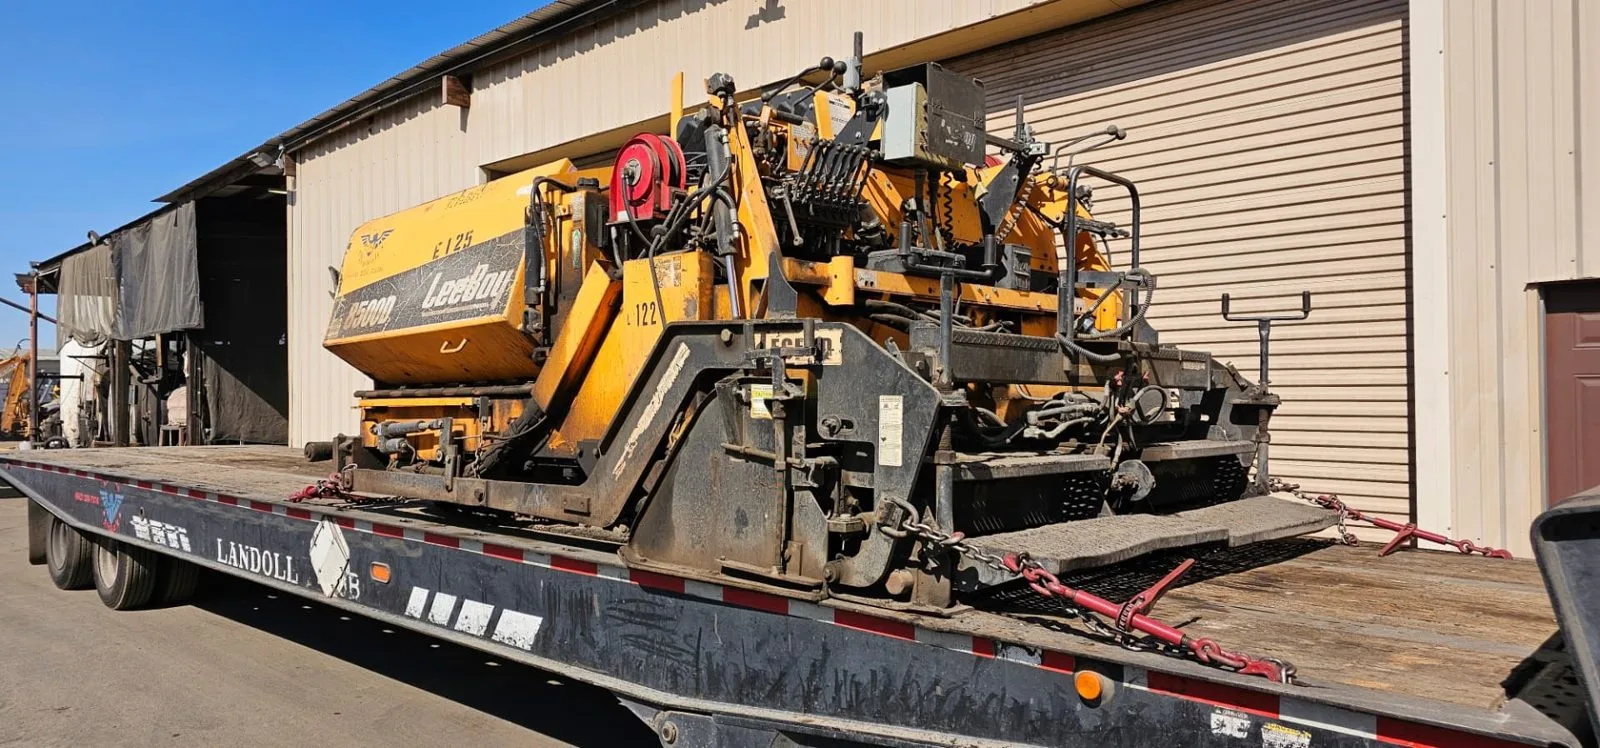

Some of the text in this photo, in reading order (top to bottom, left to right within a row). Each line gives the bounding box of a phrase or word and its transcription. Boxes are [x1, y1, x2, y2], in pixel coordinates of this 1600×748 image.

[421, 261, 515, 310] LeeBoy
[636, 301, 657, 327] 122
[216, 537, 299, 585] LANDOLL
